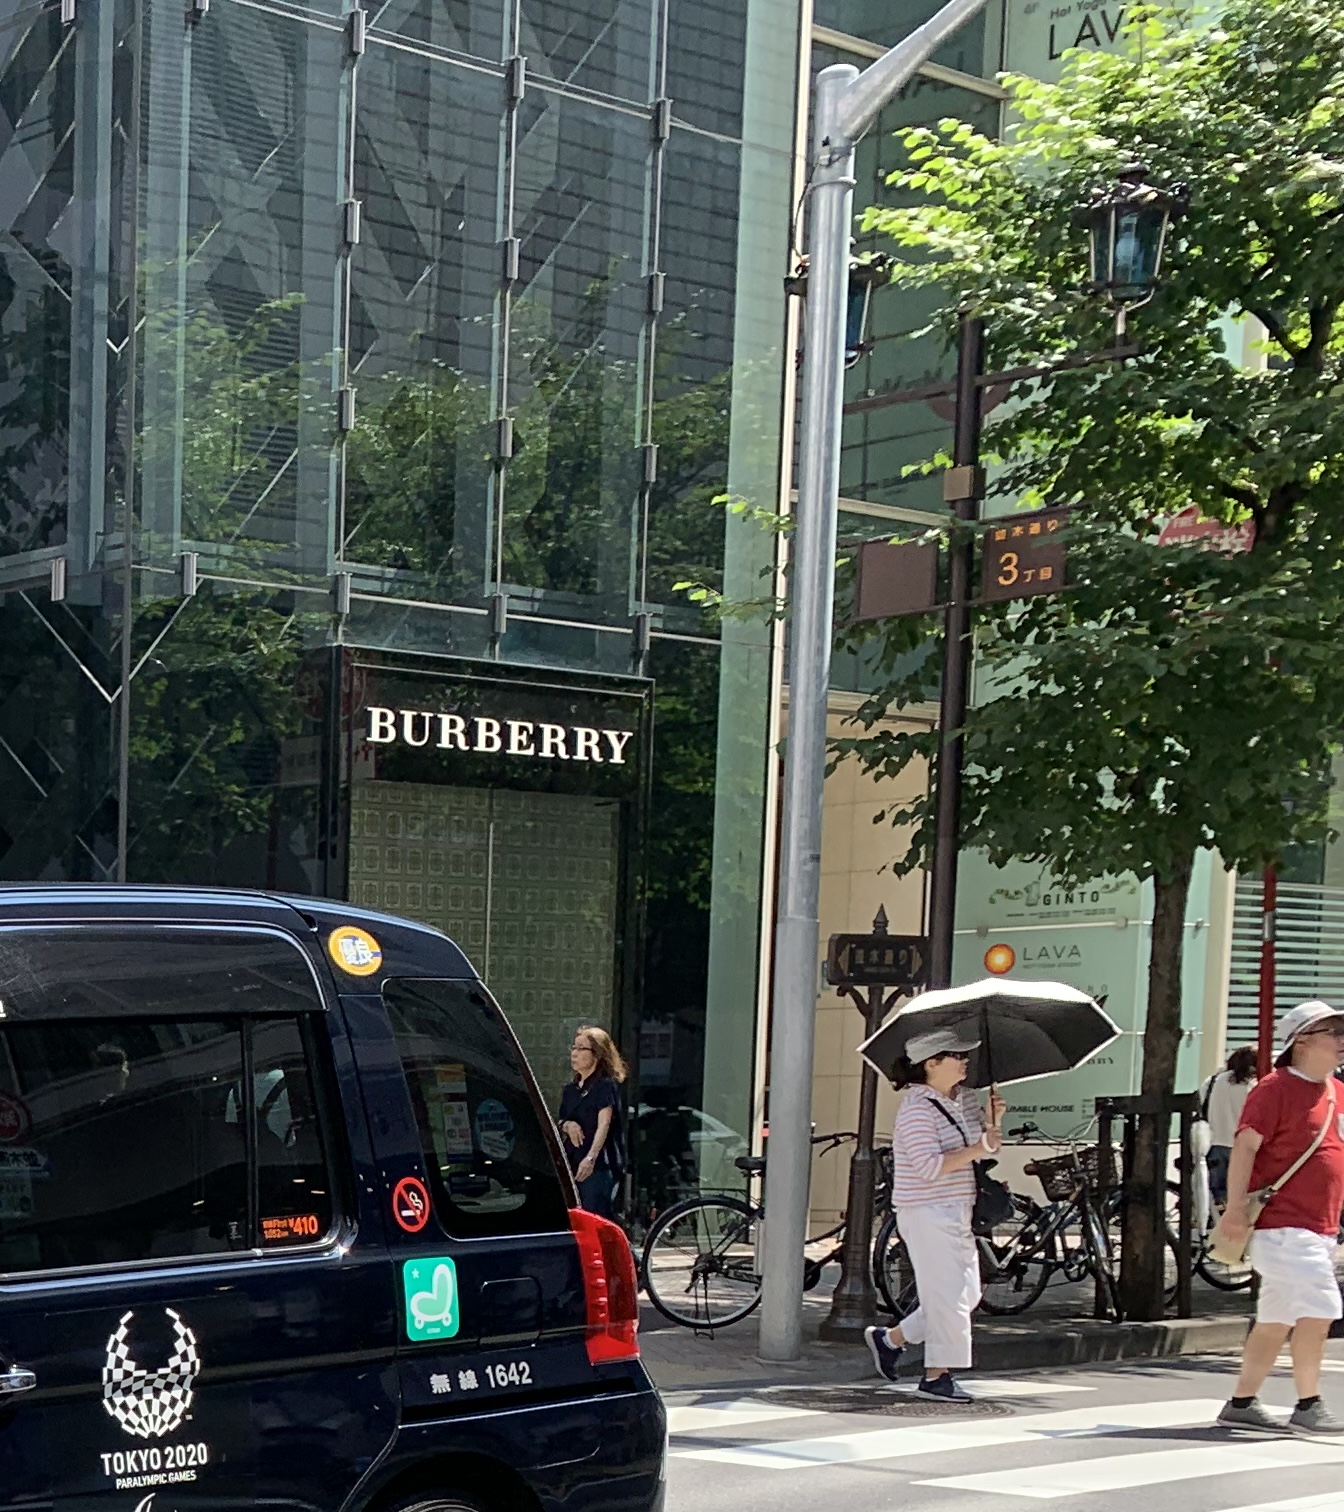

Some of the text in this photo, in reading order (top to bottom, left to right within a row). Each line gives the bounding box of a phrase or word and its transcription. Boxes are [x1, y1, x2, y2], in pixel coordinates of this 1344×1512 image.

[998, 552, 1052, 586] 3丁目
[366, 705, 634, 765] BURBERRY
[1042, 891, 1100, 906] GINTO
[1023, 945, 1081, 961] LAVA
[485, 1361, 533, 1388] 1642
[100, 1443, 208, 1476] TOKYO 2020
[116, 1470, 197, 1489] PARALYMPIC GAMES
